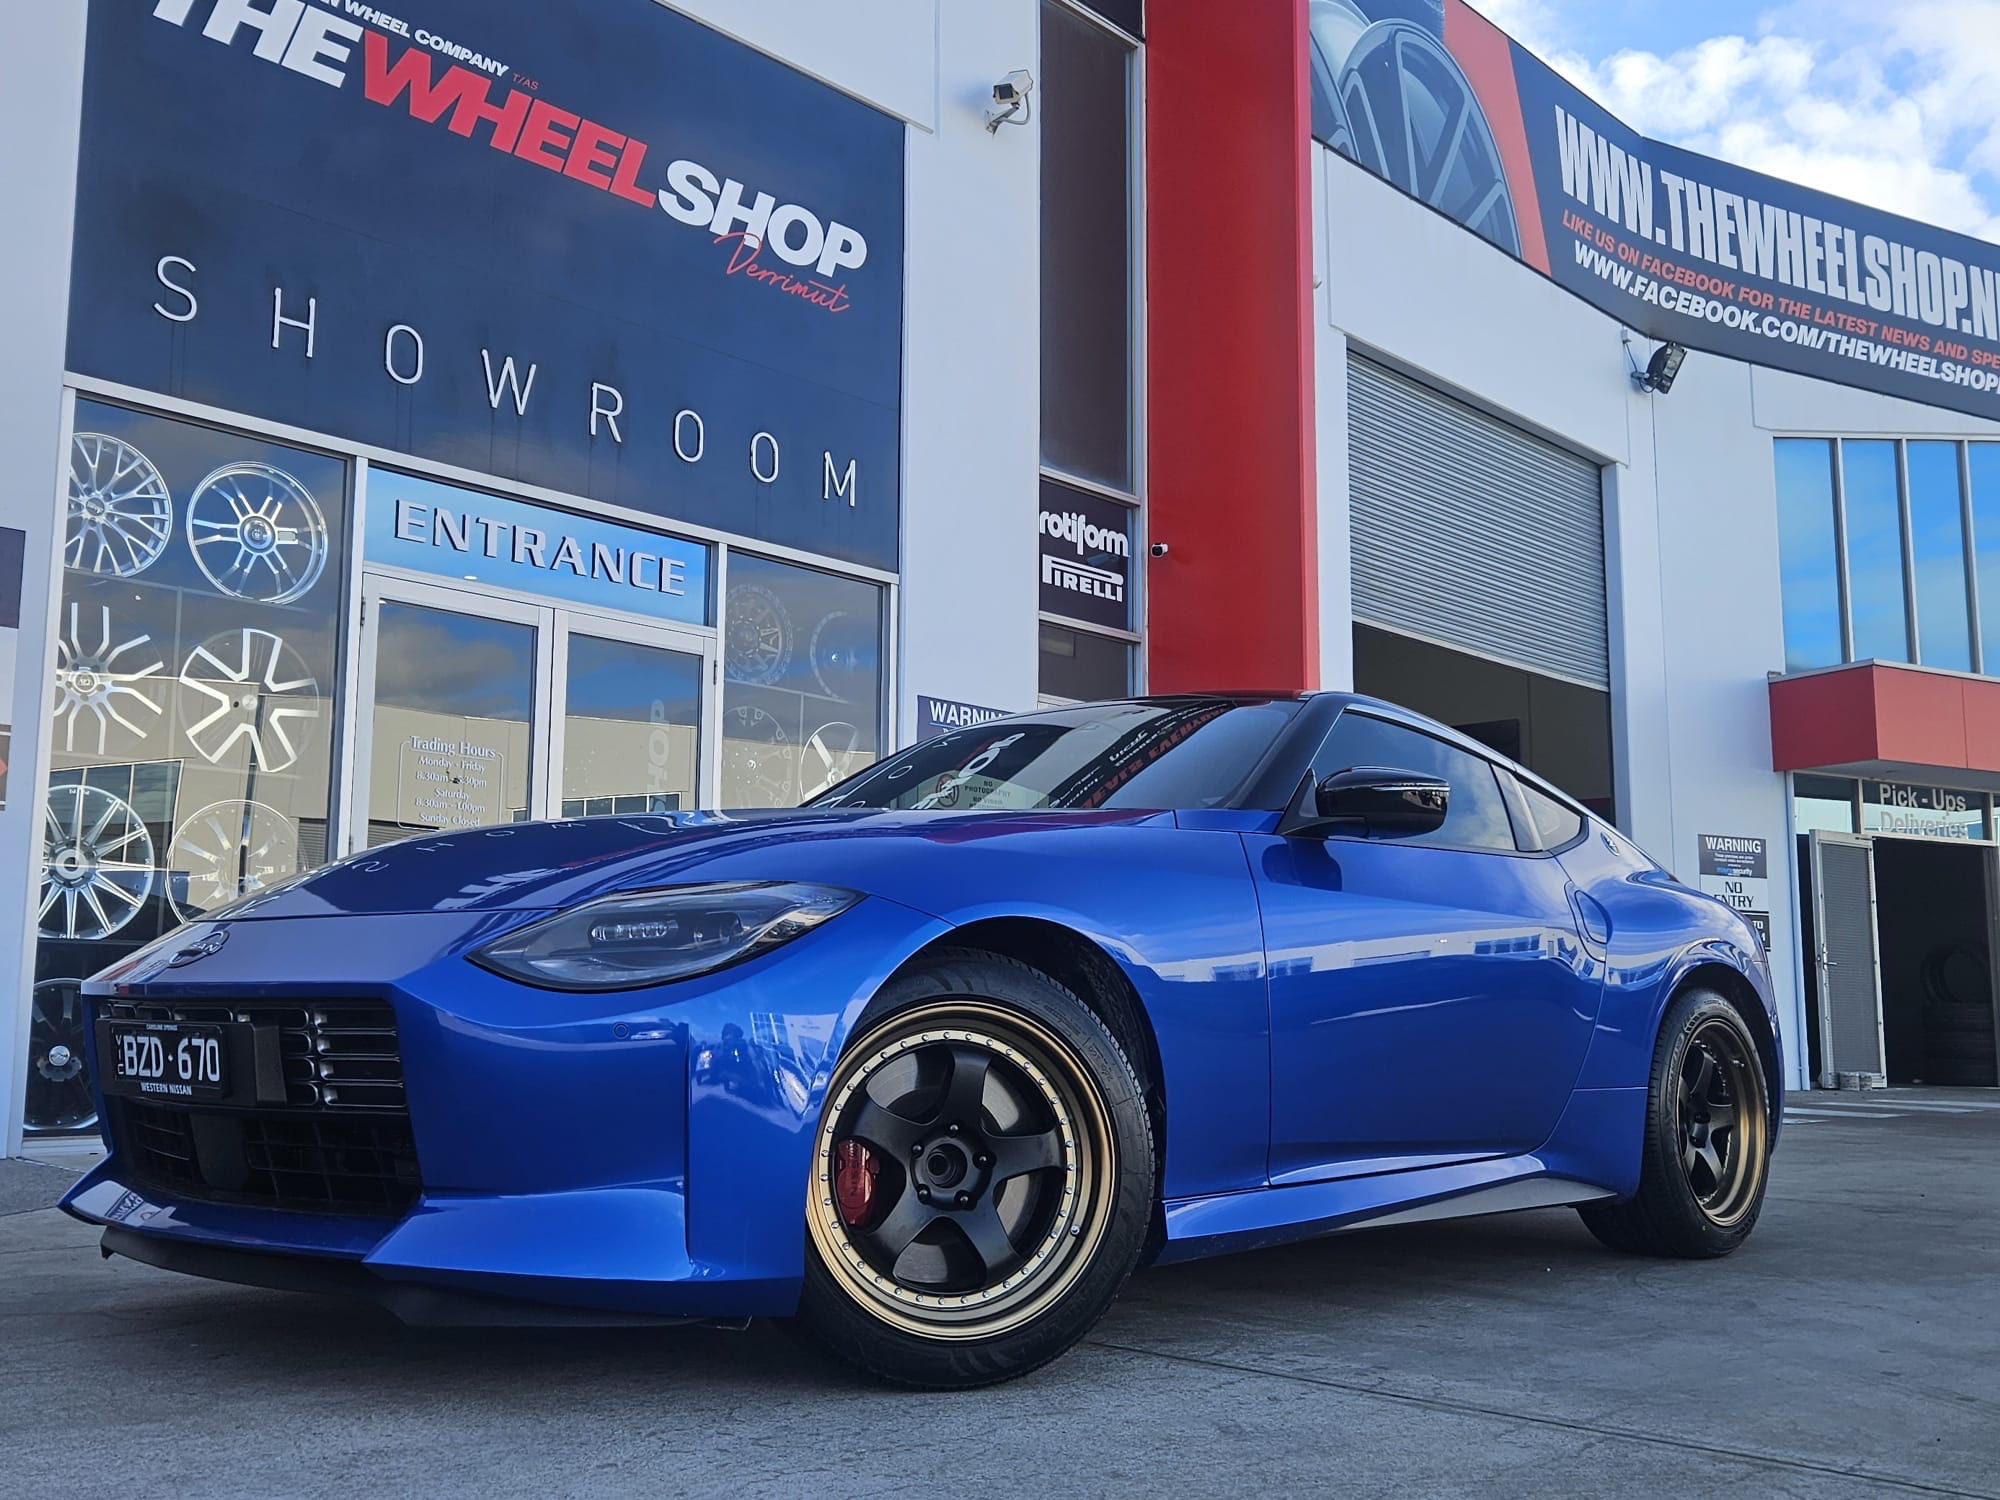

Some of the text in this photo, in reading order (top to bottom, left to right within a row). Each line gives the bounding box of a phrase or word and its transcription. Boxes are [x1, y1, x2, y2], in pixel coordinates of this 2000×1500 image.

[345, 0, 410, 38] WHEEL
[414, 28, 509, 77] COMPANY
[714, 232, 850, 312] Derrimut
[1562, 209, 1593, 240] LIKE
[1595, 231, 1616, 250] US
[1618, 242, 1639, 266] ON
[1641, 255, 1736, 299] FACEBOOK
[1738, 286, 1774, 310] FOR
[1778, 297, 1812, 320] THE
[1814, 307, 1879, 337] LATEST
[1881, 325, 1930, 351] NEWS
[1933, 340, 1968, 361] AND
[1575, 239, 2000, 395] WWW.FACEBOOK.COM/THEWHEELSHOP
[154, 256, 858, 508] SHOWROOM
[395, 499, 686, 596] ENTRANCE
[1039, 511, 1128, 557] rotiform
[1042, 554, 1124, 602] PIRELLI
[411, 736, 497, 757] Trading Hours
[418, 755, 452, 769] Monday
[461, 761, 485, 773] Friday
[434, 787, 470, 801] Saturday
[1880, 783, 1918, 808] Pick
[1932, 788, 1967, 816] Ups
[420, 811, 480, 827] Sunday Closed
[1881, 811, 1968, 837] Deliveries
[1705, 836, 1762, 854] WARNING
[1725, 881, 1743, 894] NO
[140, 1082, 192, 1096] WESTERN NISSAN
